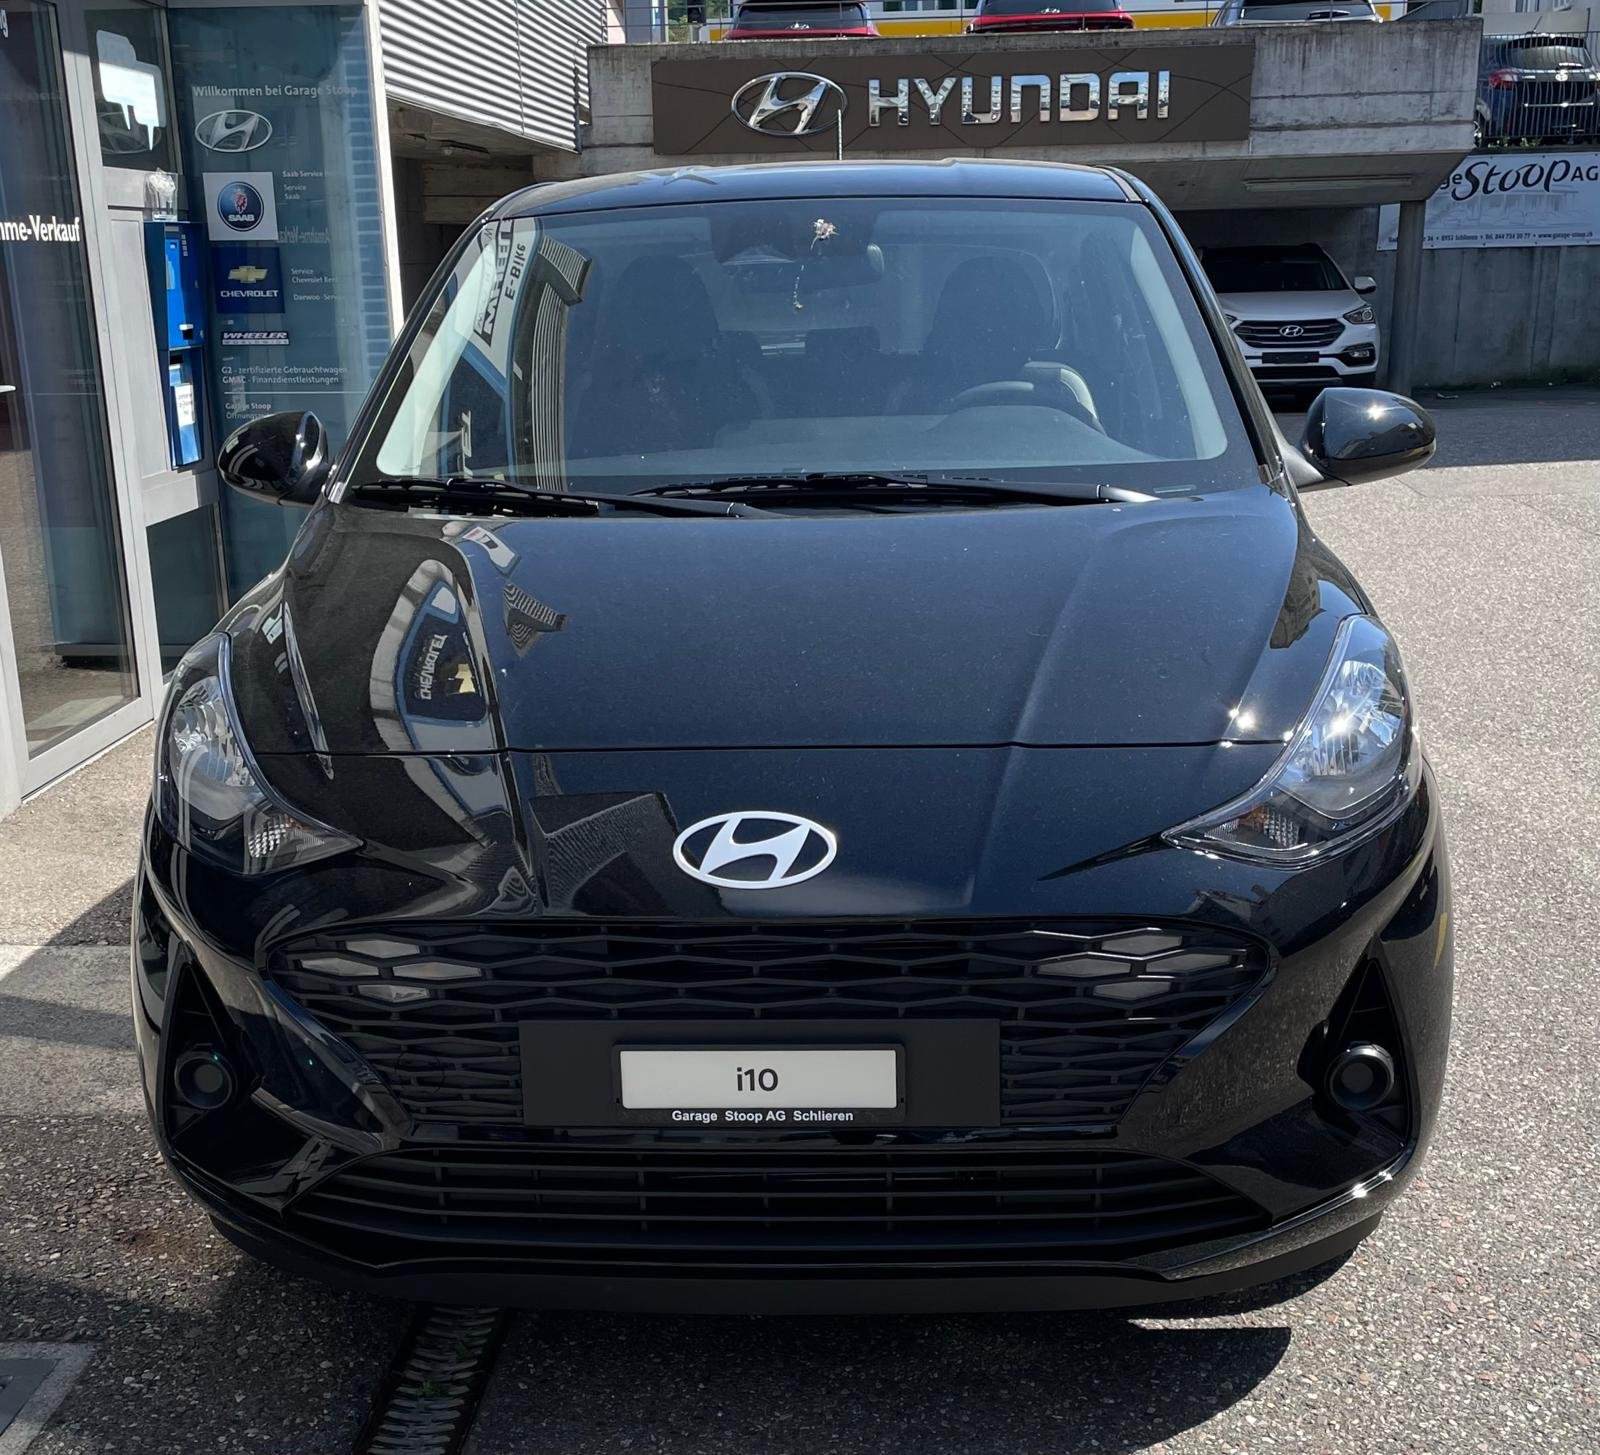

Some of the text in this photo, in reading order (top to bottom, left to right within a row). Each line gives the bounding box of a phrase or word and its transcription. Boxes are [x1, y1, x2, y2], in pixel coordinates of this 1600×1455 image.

[192, 84, 358, 99] Willkommen bei Garage Stoop
[867, 70, 1171, 128] HYUNDAI
[282, 170, 299, 178] Saab
[299, 170, 323, 178] Service
[1451, 159, 1571, 201] Stoop
[1571, 165, 1599, 182] AG
[283, 184, 307, 192] Service
[228, 213, 255, 222] SAAB
[220, 289, 279, 298] CHEVROLET
[223, 331, 288, 339] WHEELER
[221, 365, 348, 376] G2 zertifizierte Gebrauchtwagen
[222, 375, 339, 386] GMAC Finanzdienstleistungen
[251, 402, 272, 411] Stoop
[736, 1066, 780, 1092] i10
[671, 1109, 854, 1124] Garage Stoop AG Schlieren
